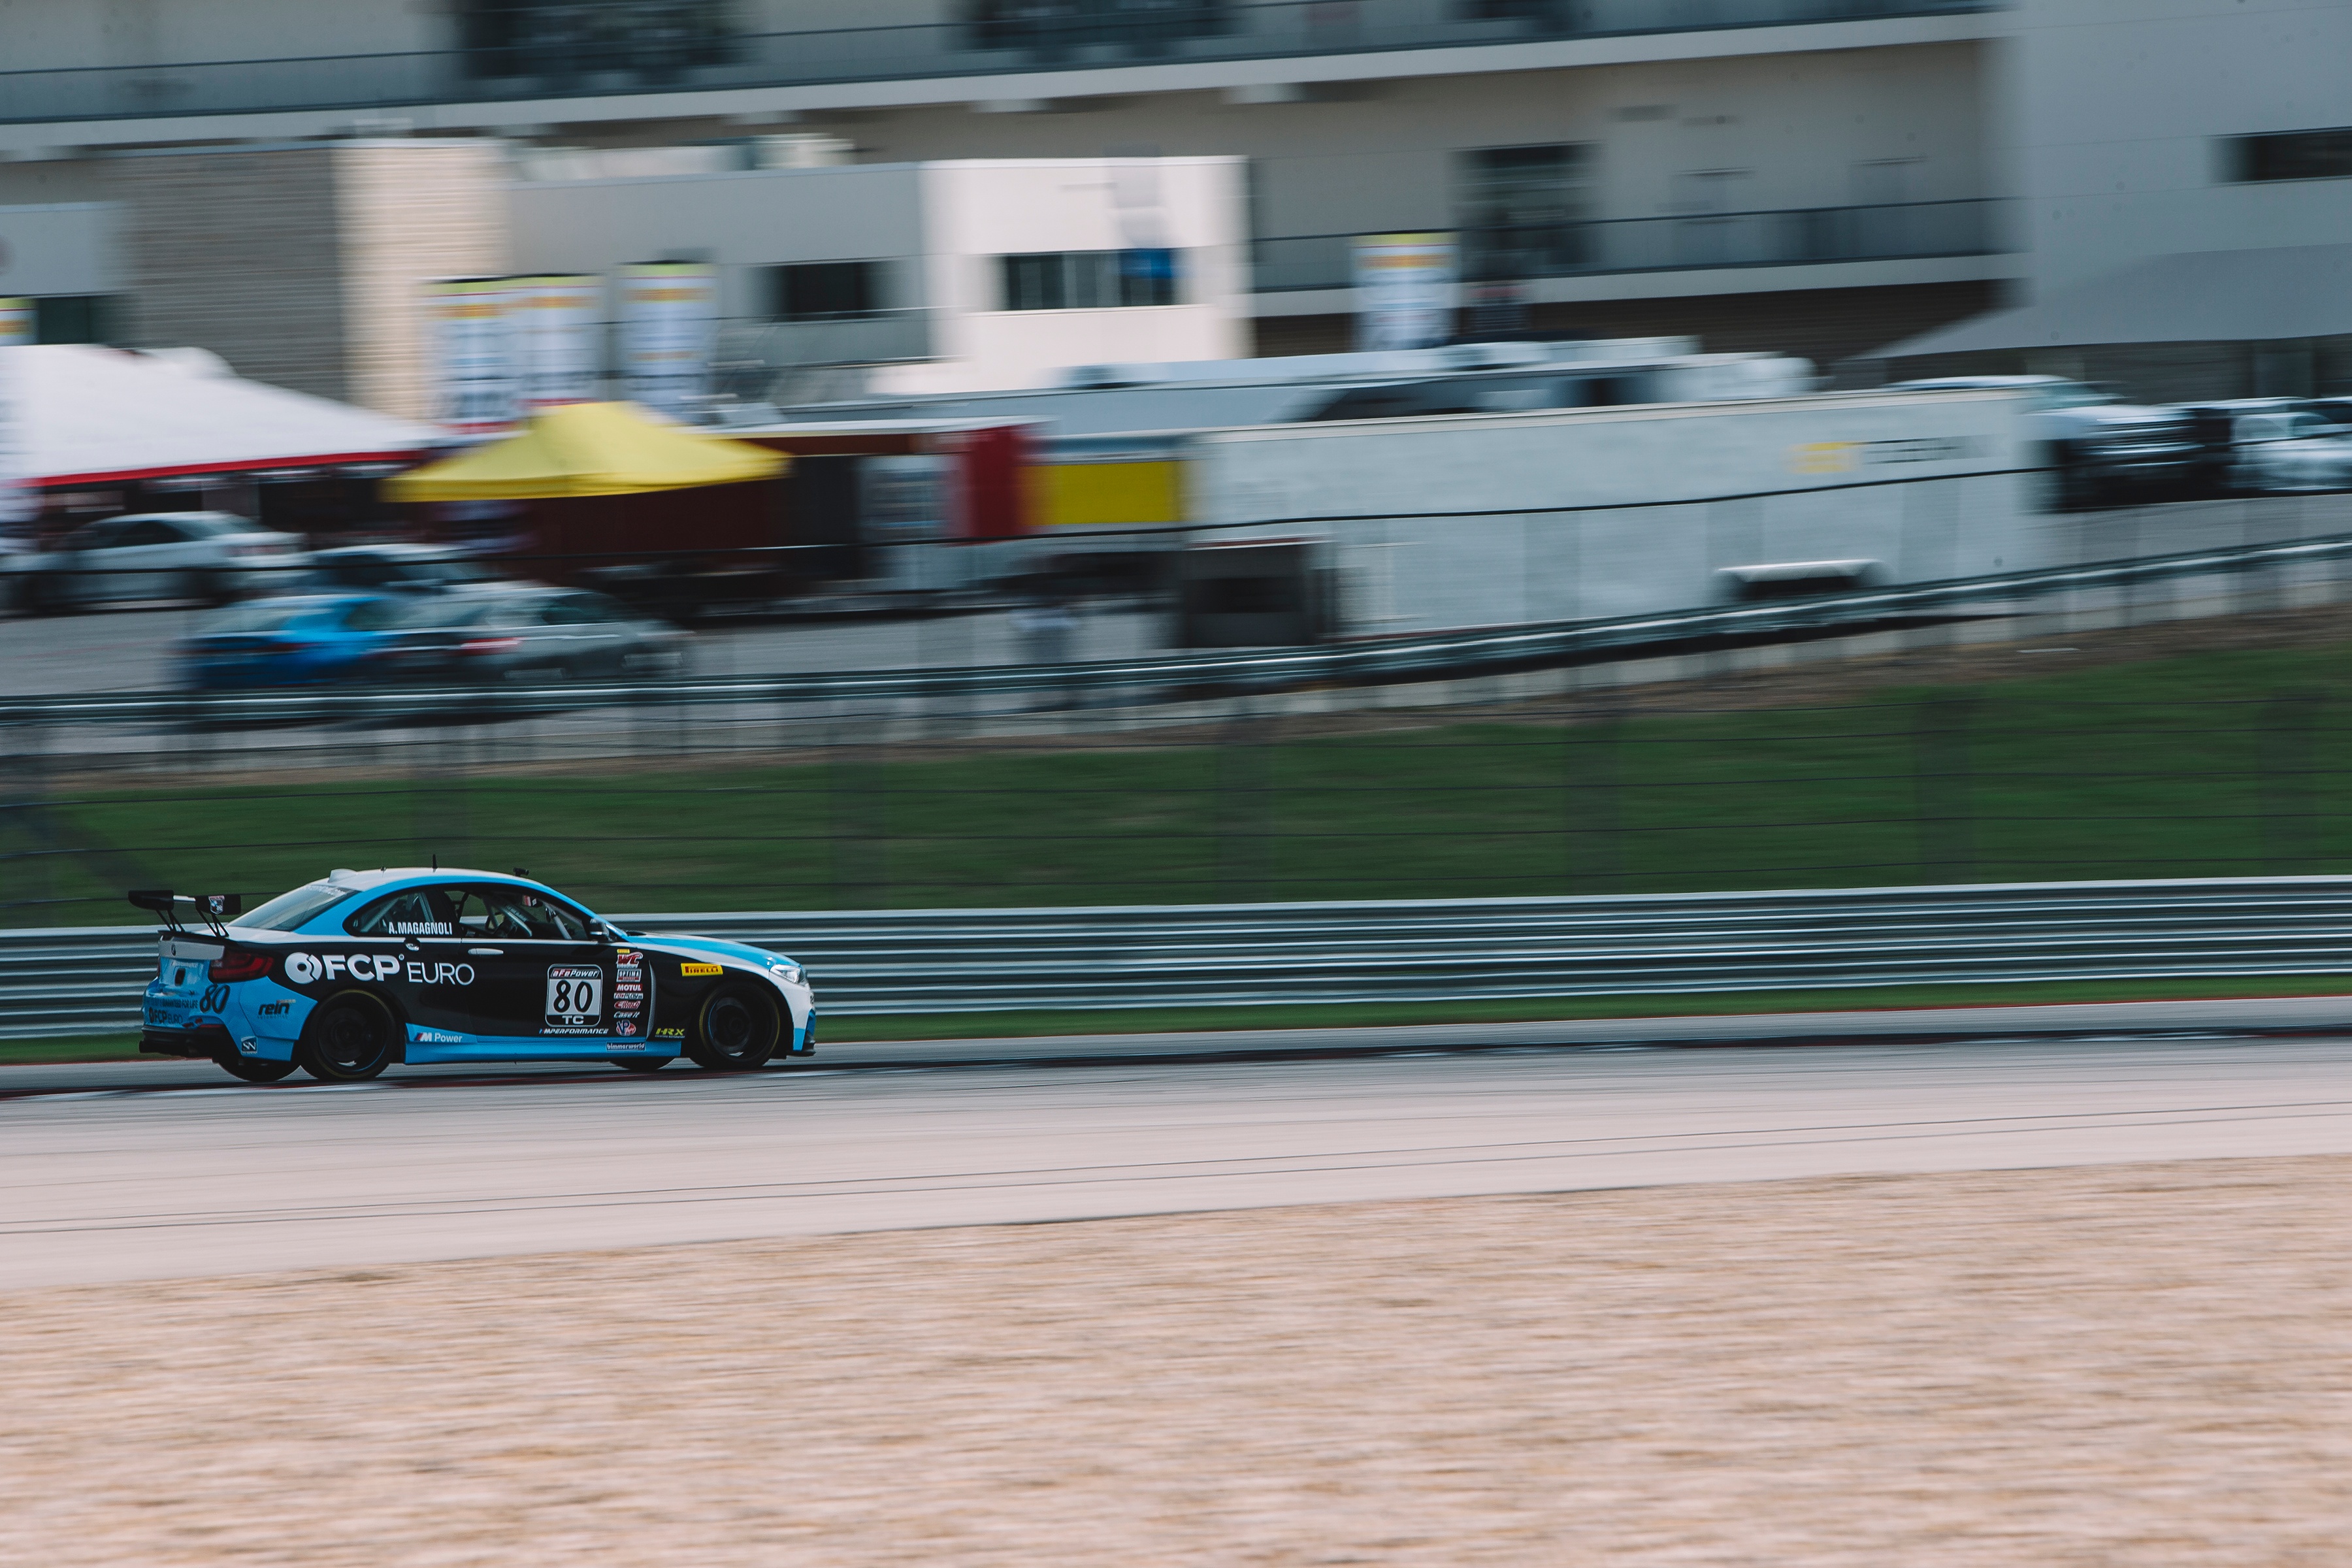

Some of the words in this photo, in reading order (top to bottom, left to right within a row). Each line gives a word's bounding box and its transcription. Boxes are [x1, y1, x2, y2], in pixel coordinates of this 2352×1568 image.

[389, 922, 453, 935] A.MAGAGNOLI
[406, 962, 475, 985] EURO
[199, 984, 231, 1015] 80
[553, 979, 593, 1013] 80
[258, 1002, 290, 1015] rein
[154, 1009, 167, 1024] FCP
[168, 1013, 183, 1024] EURO
[562, 1015, 584, 1024] TC
[434, 1032, 463, 1043] Power
